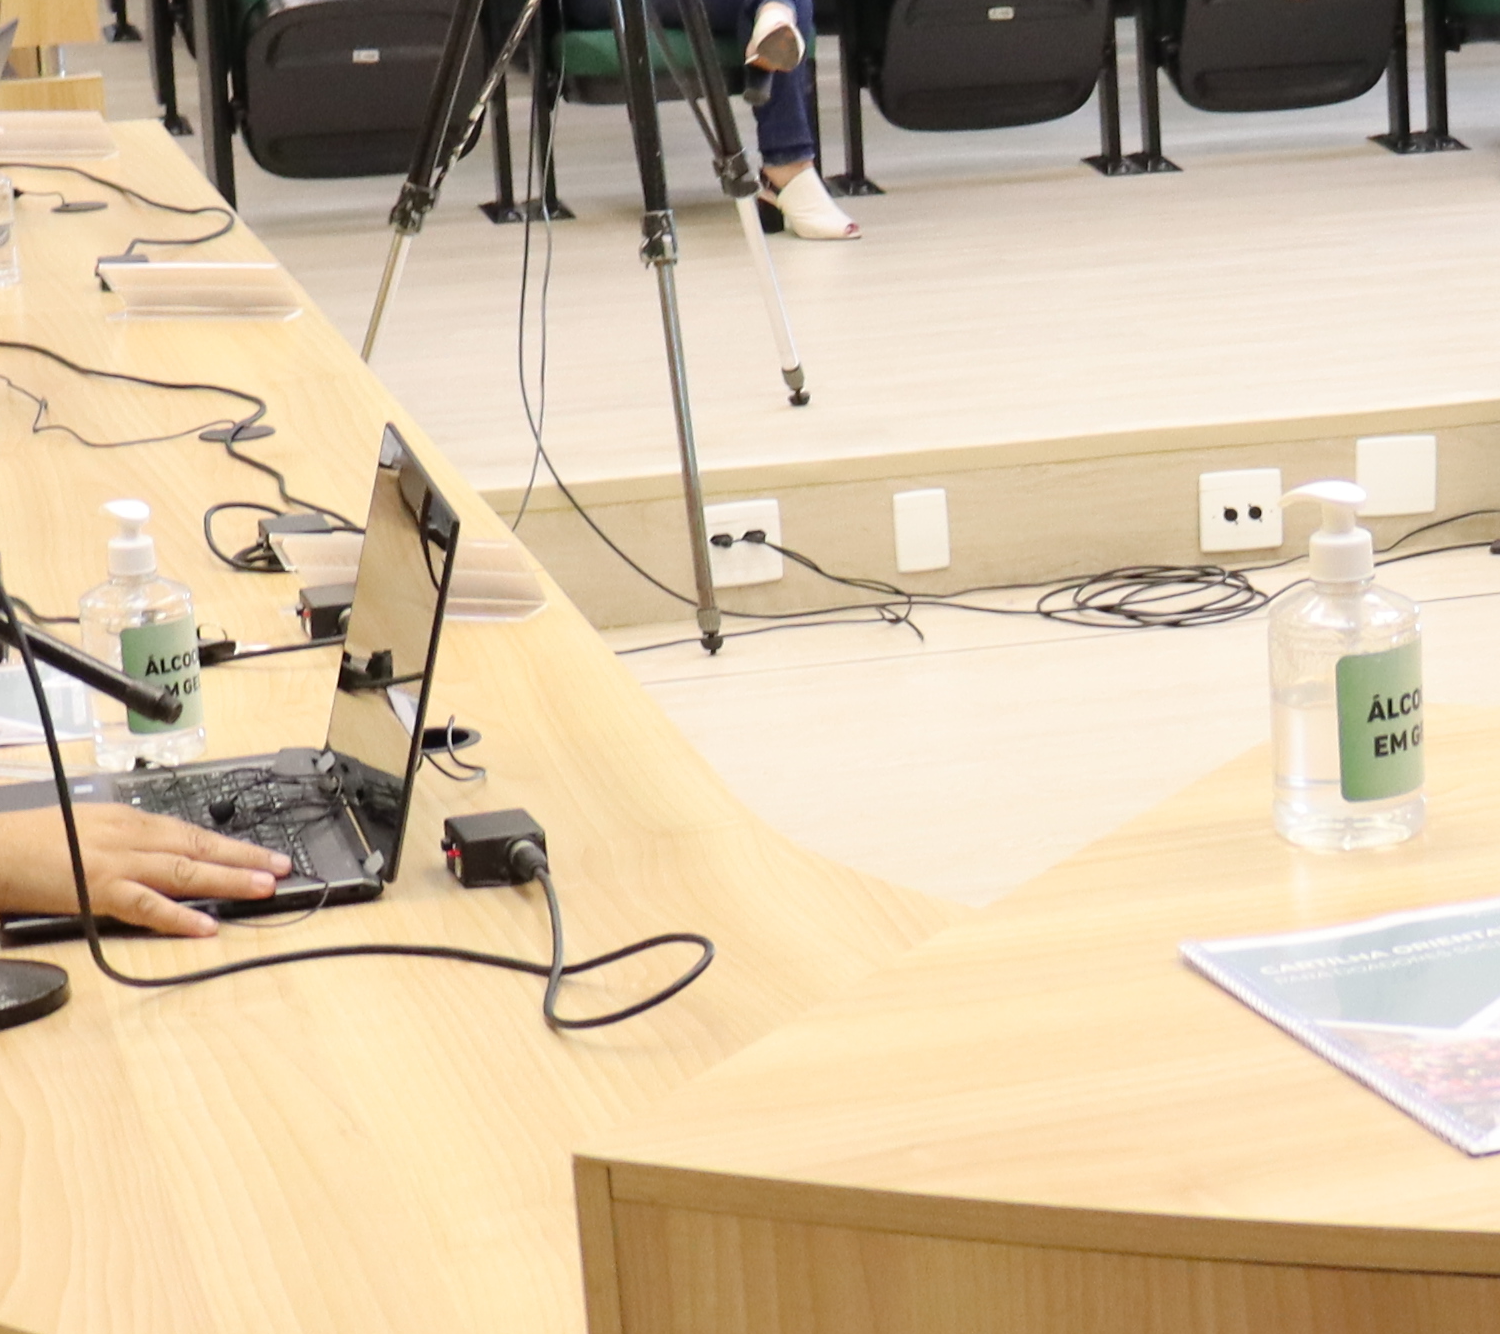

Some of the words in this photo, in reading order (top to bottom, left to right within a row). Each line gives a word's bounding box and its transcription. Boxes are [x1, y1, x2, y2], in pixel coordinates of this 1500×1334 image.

[183, 677, 200, 696] GE
[1374, 731, 1407, 758] EM
[1261, 949, 1389, 975] CARTILHA
